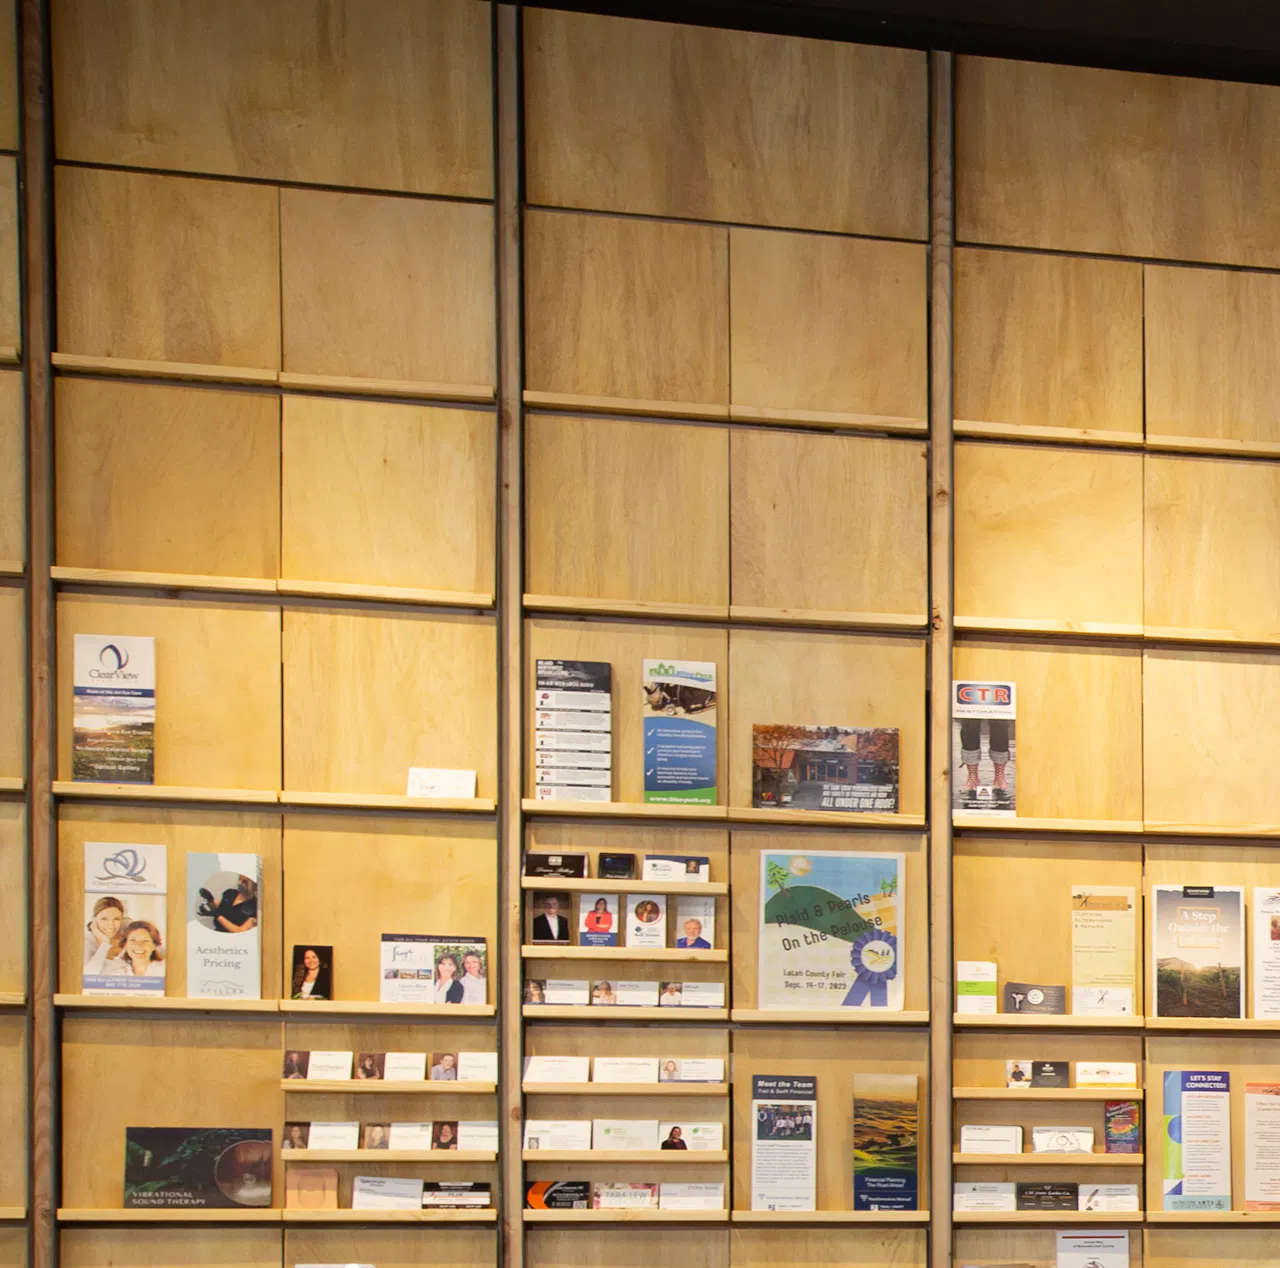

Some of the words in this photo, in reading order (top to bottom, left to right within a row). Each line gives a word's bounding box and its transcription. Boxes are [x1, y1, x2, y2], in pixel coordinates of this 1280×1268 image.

[958, 686, 1009, 703] CTR
[821, 797, 835, 807] ALL
[835, 798, 859, 808] UNDER
[859, 799, 875, 808] ONE
[776, 908, 809, 928] Plaid
[813, 904, 824, 918] &
[828, 893, 871, 914] Pearls
[1180, 911, 1190, 921] A
[1191, 911, 1217, 923] Step
[782, 937, 802, 951] On
[804, 930, 828, 946] the
[830, 915, 883, 937] Palouse
[1211, 923, 1230, 933] the
[195, 945, 248, 956] Aesthetics
[203, 958, 242, 970] Pricing
[805, 969, 830, 979] County
[831, 970, 847, 979] Fair
[757, 1080, 777, 1088] Meet
[778, 1080, 792, 1088] the
[793, 1081, 814, 1089] Team
[132, 1191, 193, 1199] VIBRATIONAL
[167, 1198, 207, 1206] THERAPY
